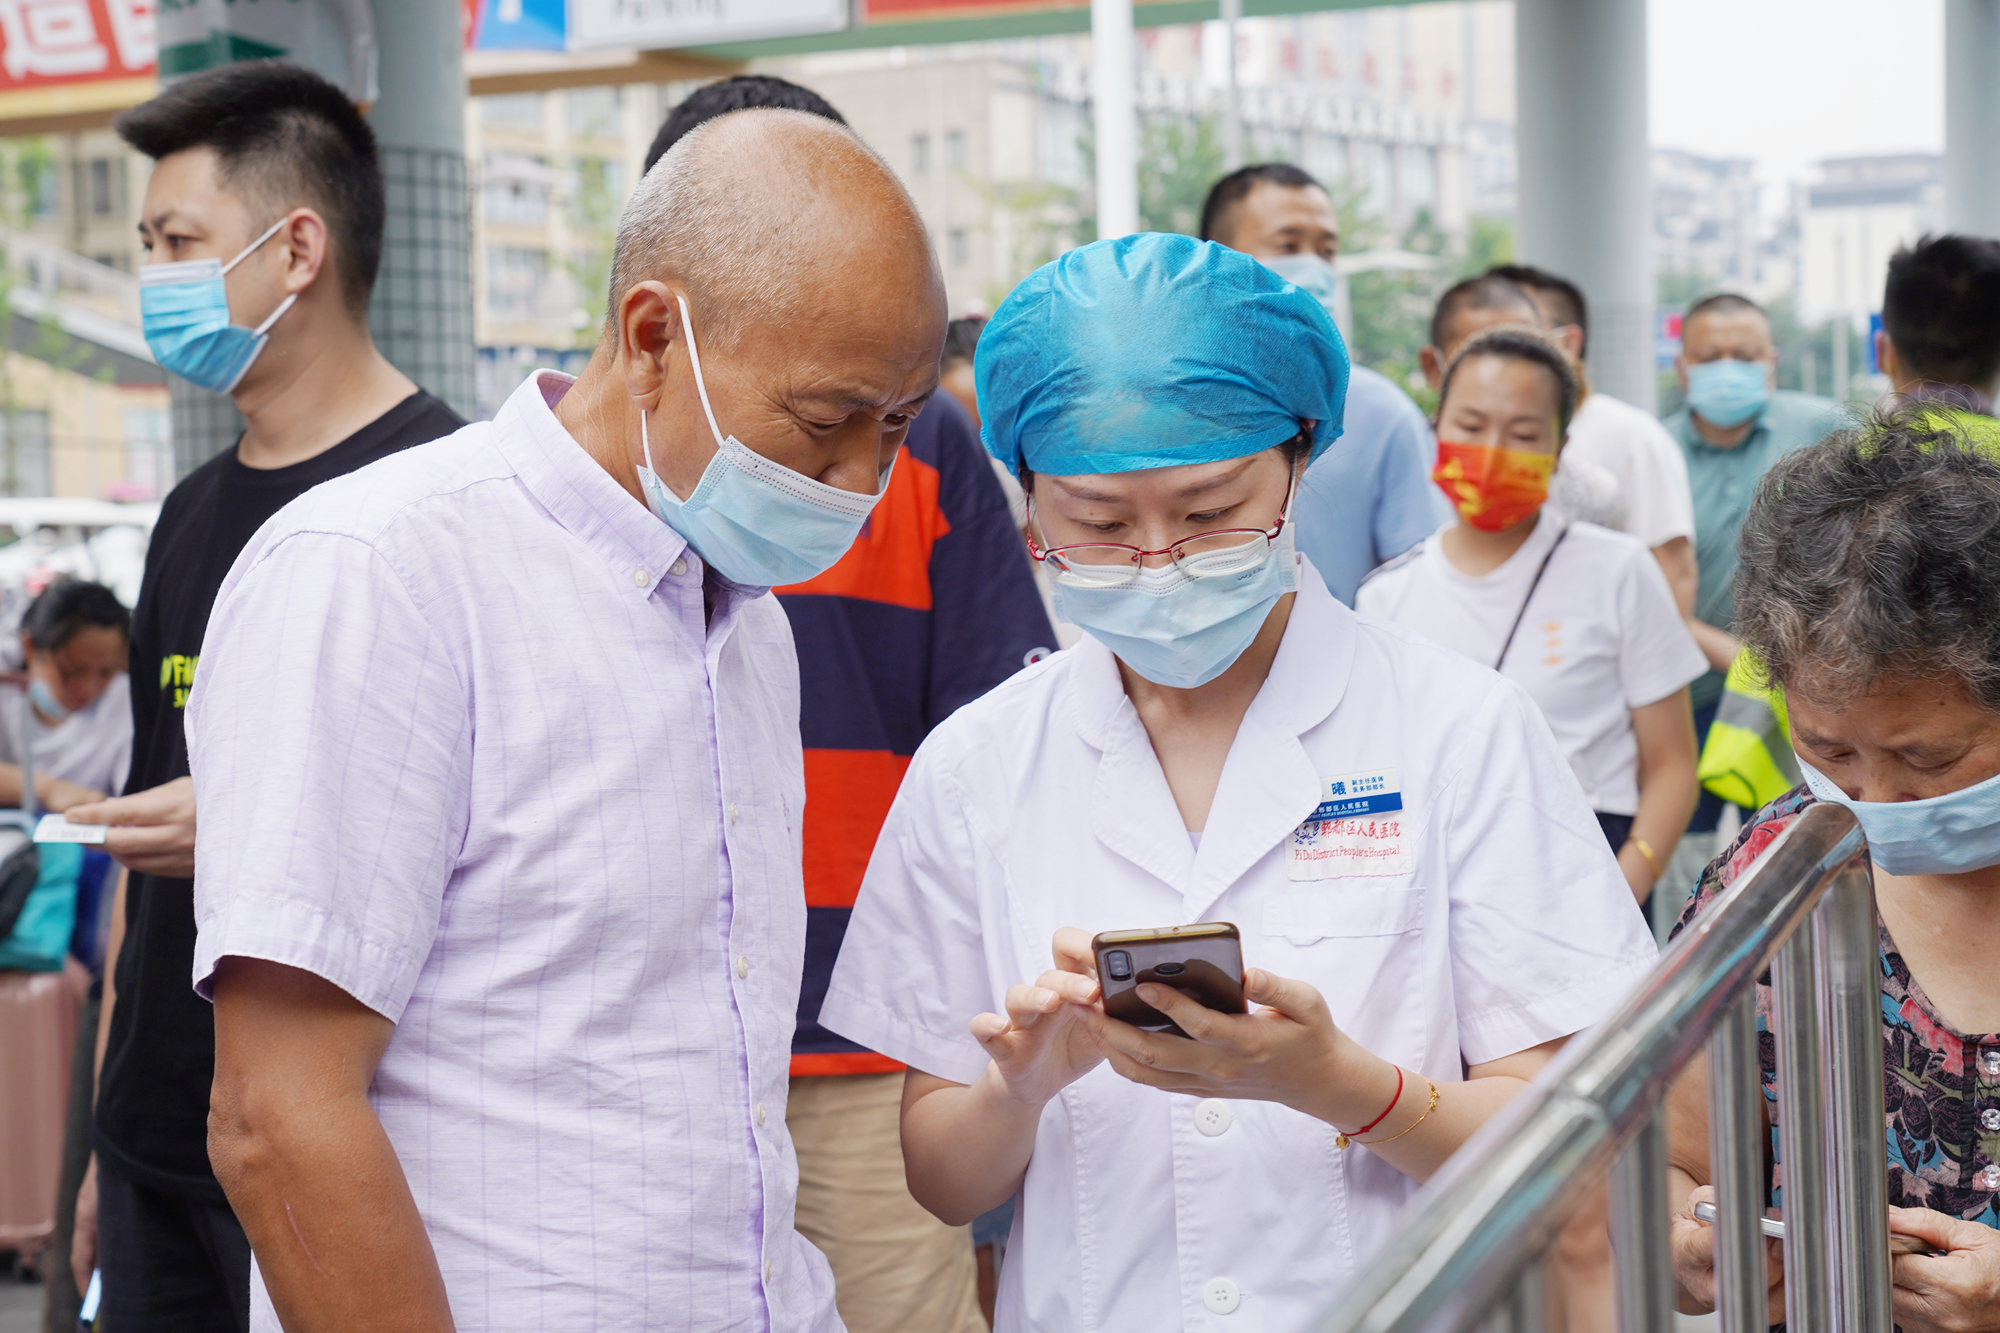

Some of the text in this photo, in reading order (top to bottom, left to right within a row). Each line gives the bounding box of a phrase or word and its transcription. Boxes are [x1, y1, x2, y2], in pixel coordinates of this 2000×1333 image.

[1321, 819, 1401, 840] 郫都区人民医院
[1294, 848, 1302, 860] Pi
[1313, 847, 1339, 860] District
[1339, 845, 1369, 860] People's
[1369, 844, 1400, 860] Hospital
